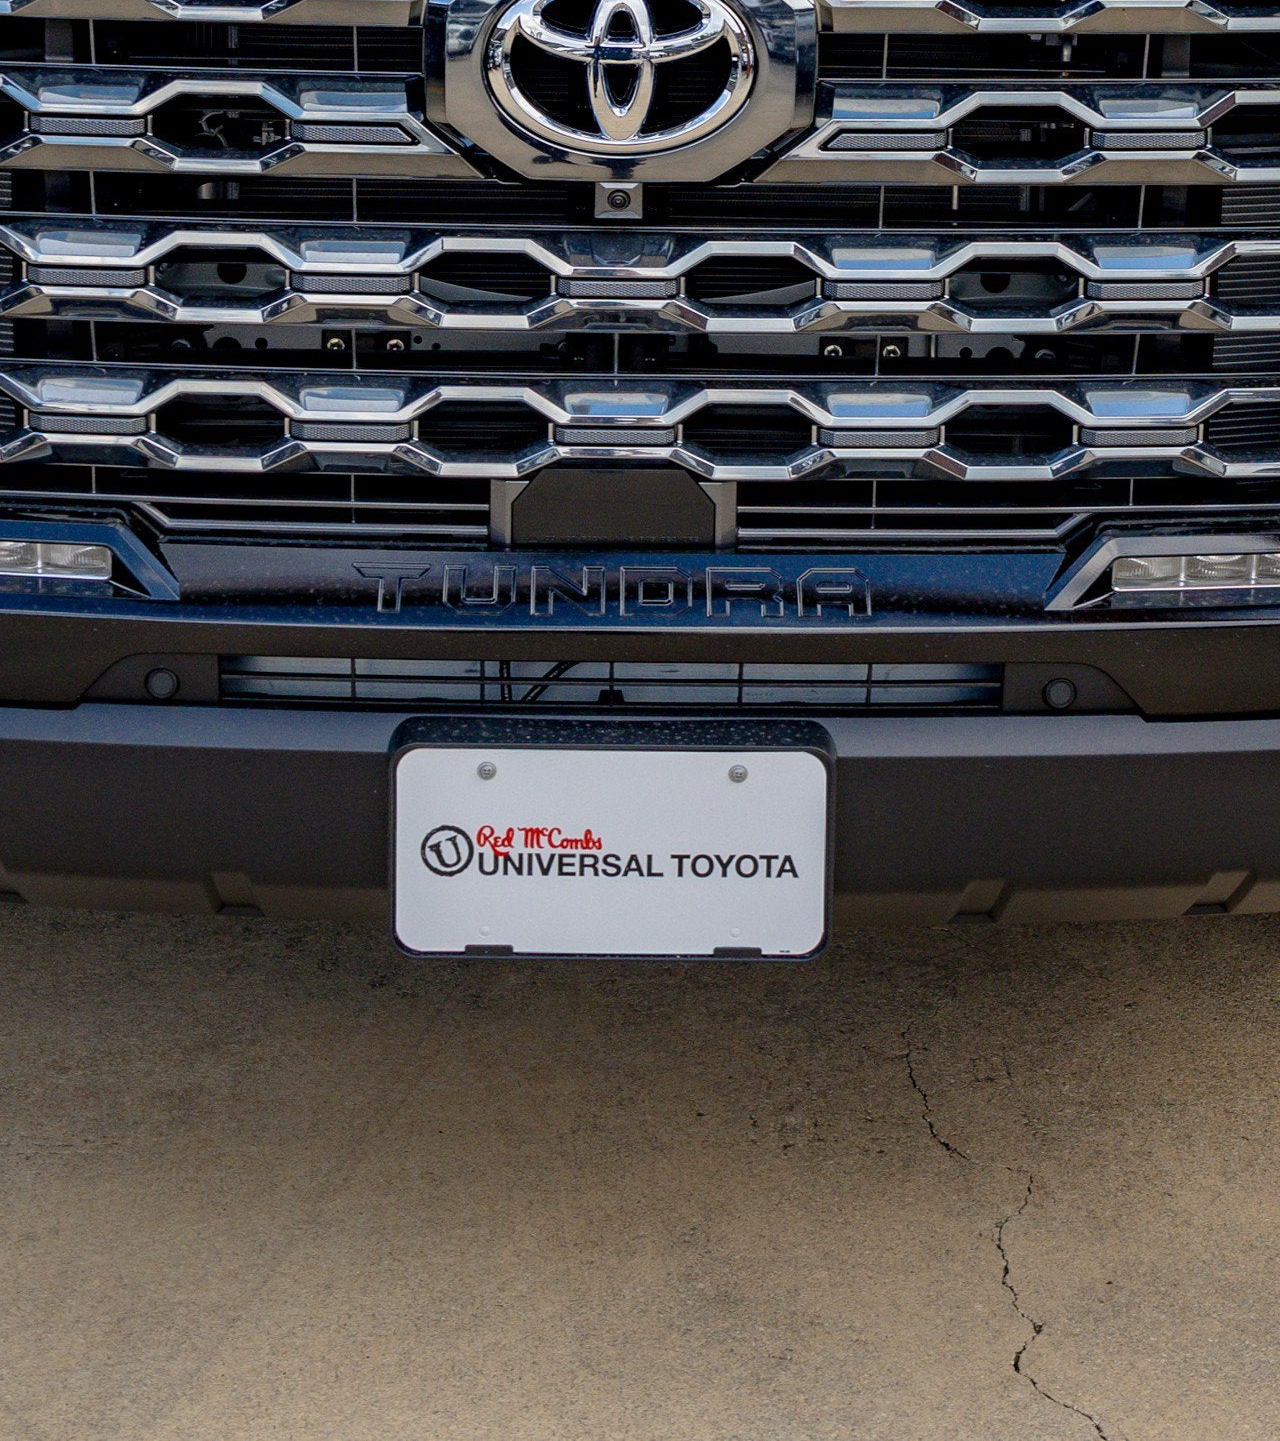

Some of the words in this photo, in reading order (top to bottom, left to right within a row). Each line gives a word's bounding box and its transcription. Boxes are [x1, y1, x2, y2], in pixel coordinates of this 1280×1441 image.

[351, 561, 873, 618] TUNDRA
[476, 825, 514, 857] Red
[518, 825, 603, 851] McCombs
[477, 853, 665, 878] UNIVERSAL
[670, 854, 800, 879] TOYOTA
